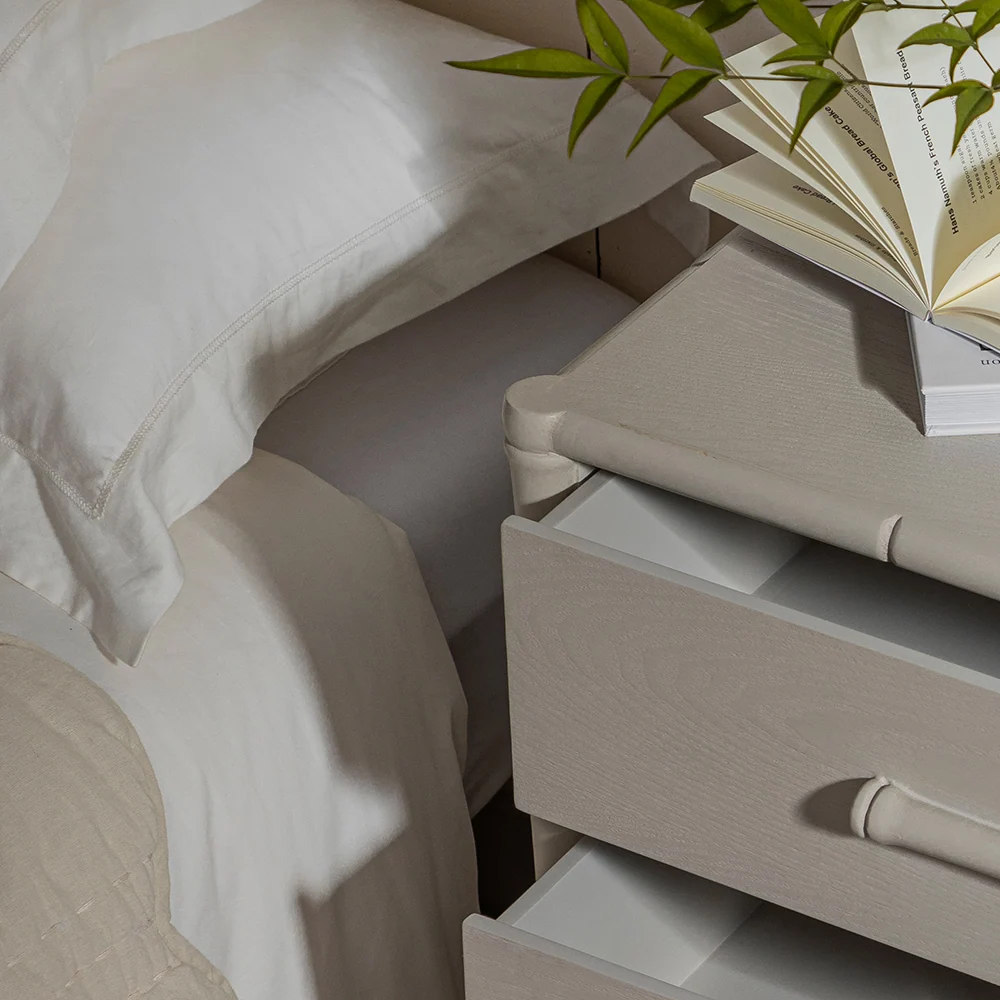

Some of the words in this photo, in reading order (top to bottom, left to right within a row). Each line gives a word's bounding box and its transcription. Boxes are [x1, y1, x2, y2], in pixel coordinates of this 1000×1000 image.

[895, 49, 911, 79] Bread
[823, 104, 844, 126] Cake
[841, 123, 866, 148] Bread
[918, 123, 937, 158] French
[968, 127, 980, 148] water
[986, 121, 997, 139] germ
[964, 145, 974, 163] fresh
[977, 129, 992, 156] pounds
[862, 145, 889, 173] Global
[975, 149, 986, 170] warm
[930, 159, 953, 206] Namuth's
[961, 165, 976, 198] teaspoon
[972, 172, 984, 193] cakes
[982, 171, 993, 189] cups
[990, 169, 1000, 190] About
[945, 207, 960, 234] Hans
